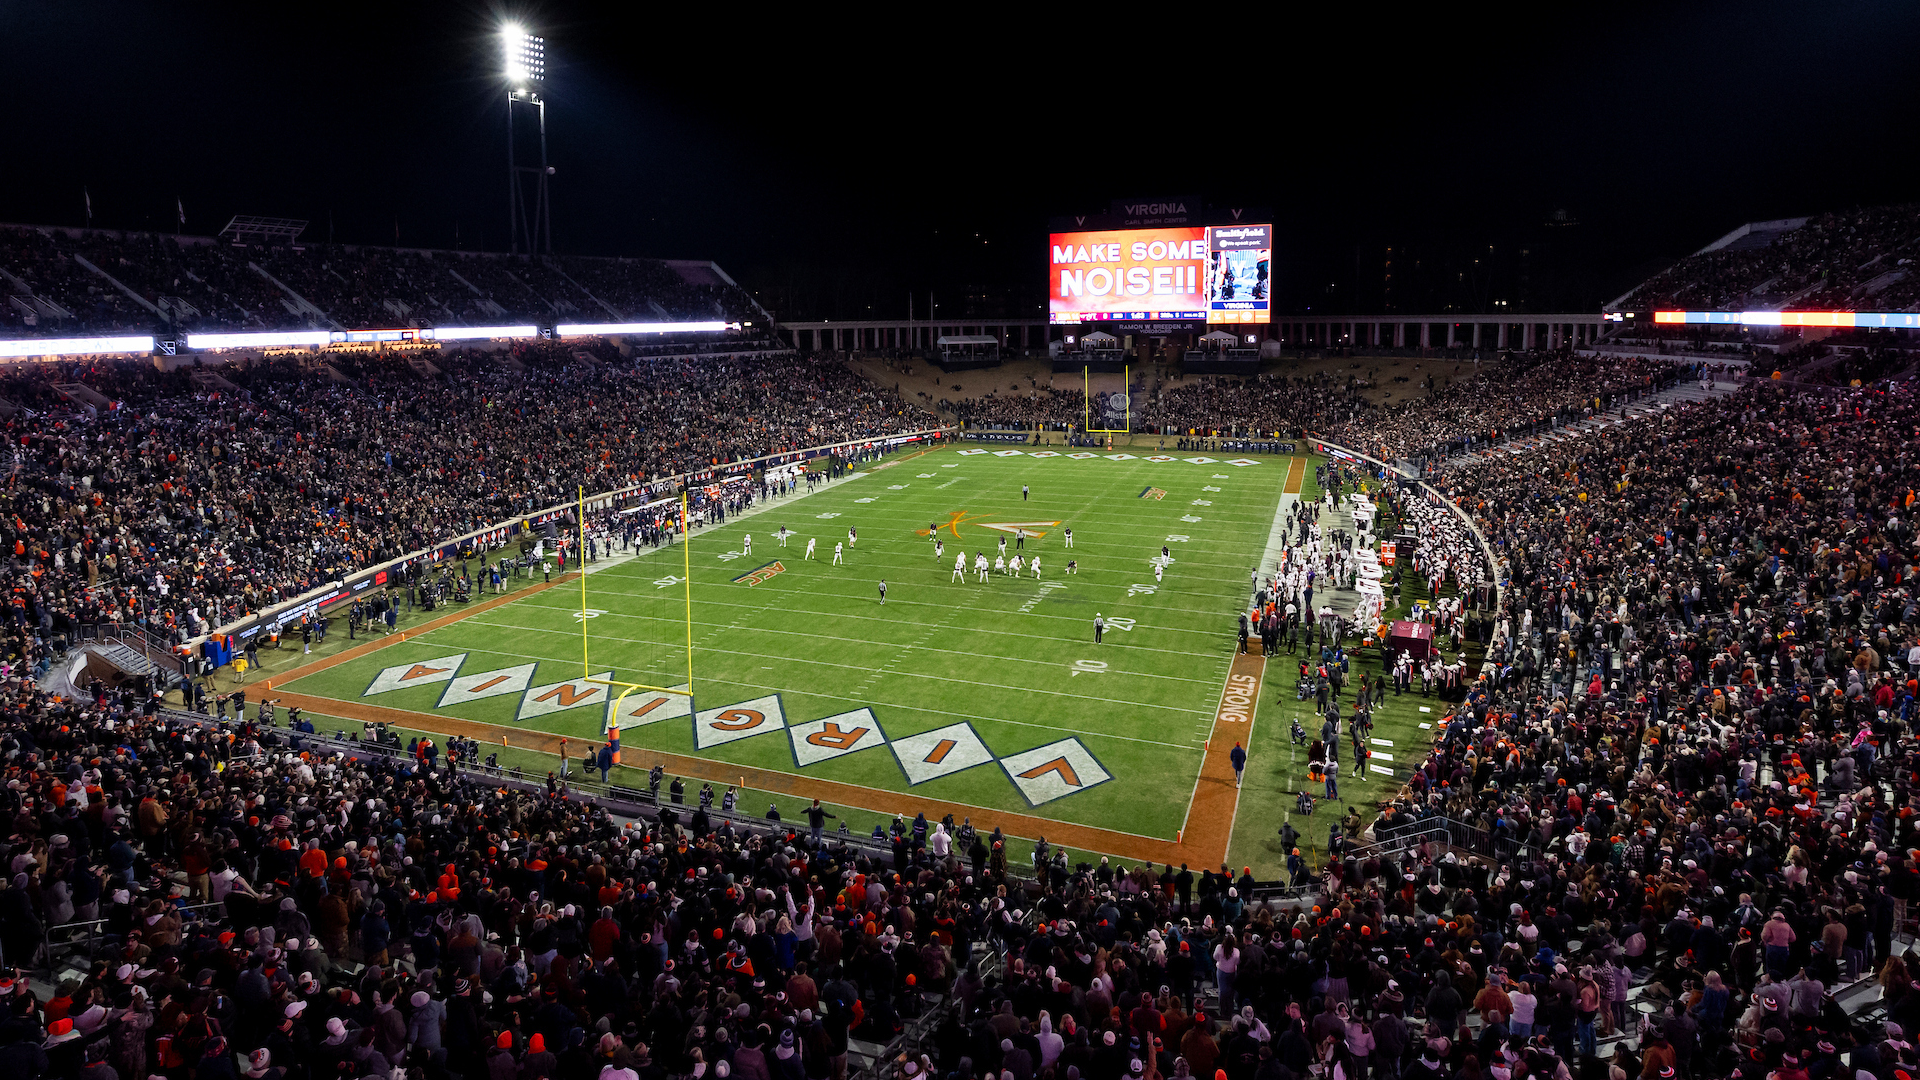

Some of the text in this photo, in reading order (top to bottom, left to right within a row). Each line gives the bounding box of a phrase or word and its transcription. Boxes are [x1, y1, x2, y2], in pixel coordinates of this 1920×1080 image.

[1125, 203, 1187, 215] VIRGINIA
[1053, 240, 1205, 264] MAKE SOME
[1060, 266, 1196, 297] NOISE!!
[10, 338, 114, 355] THIRD DOWN
[1104, 410, 1137, 420] Allstate
[653, 575, 687, 586] 20
[734, 560, 787, 587] ACC
[1129, 583, 1158, 595] 30
[573, 608, 609, 619] 10
[1104, 617, 1136, 632] 20
[1071, 659, 1108, 674] 10
[1219, 674, 1257, 723] STRONG
